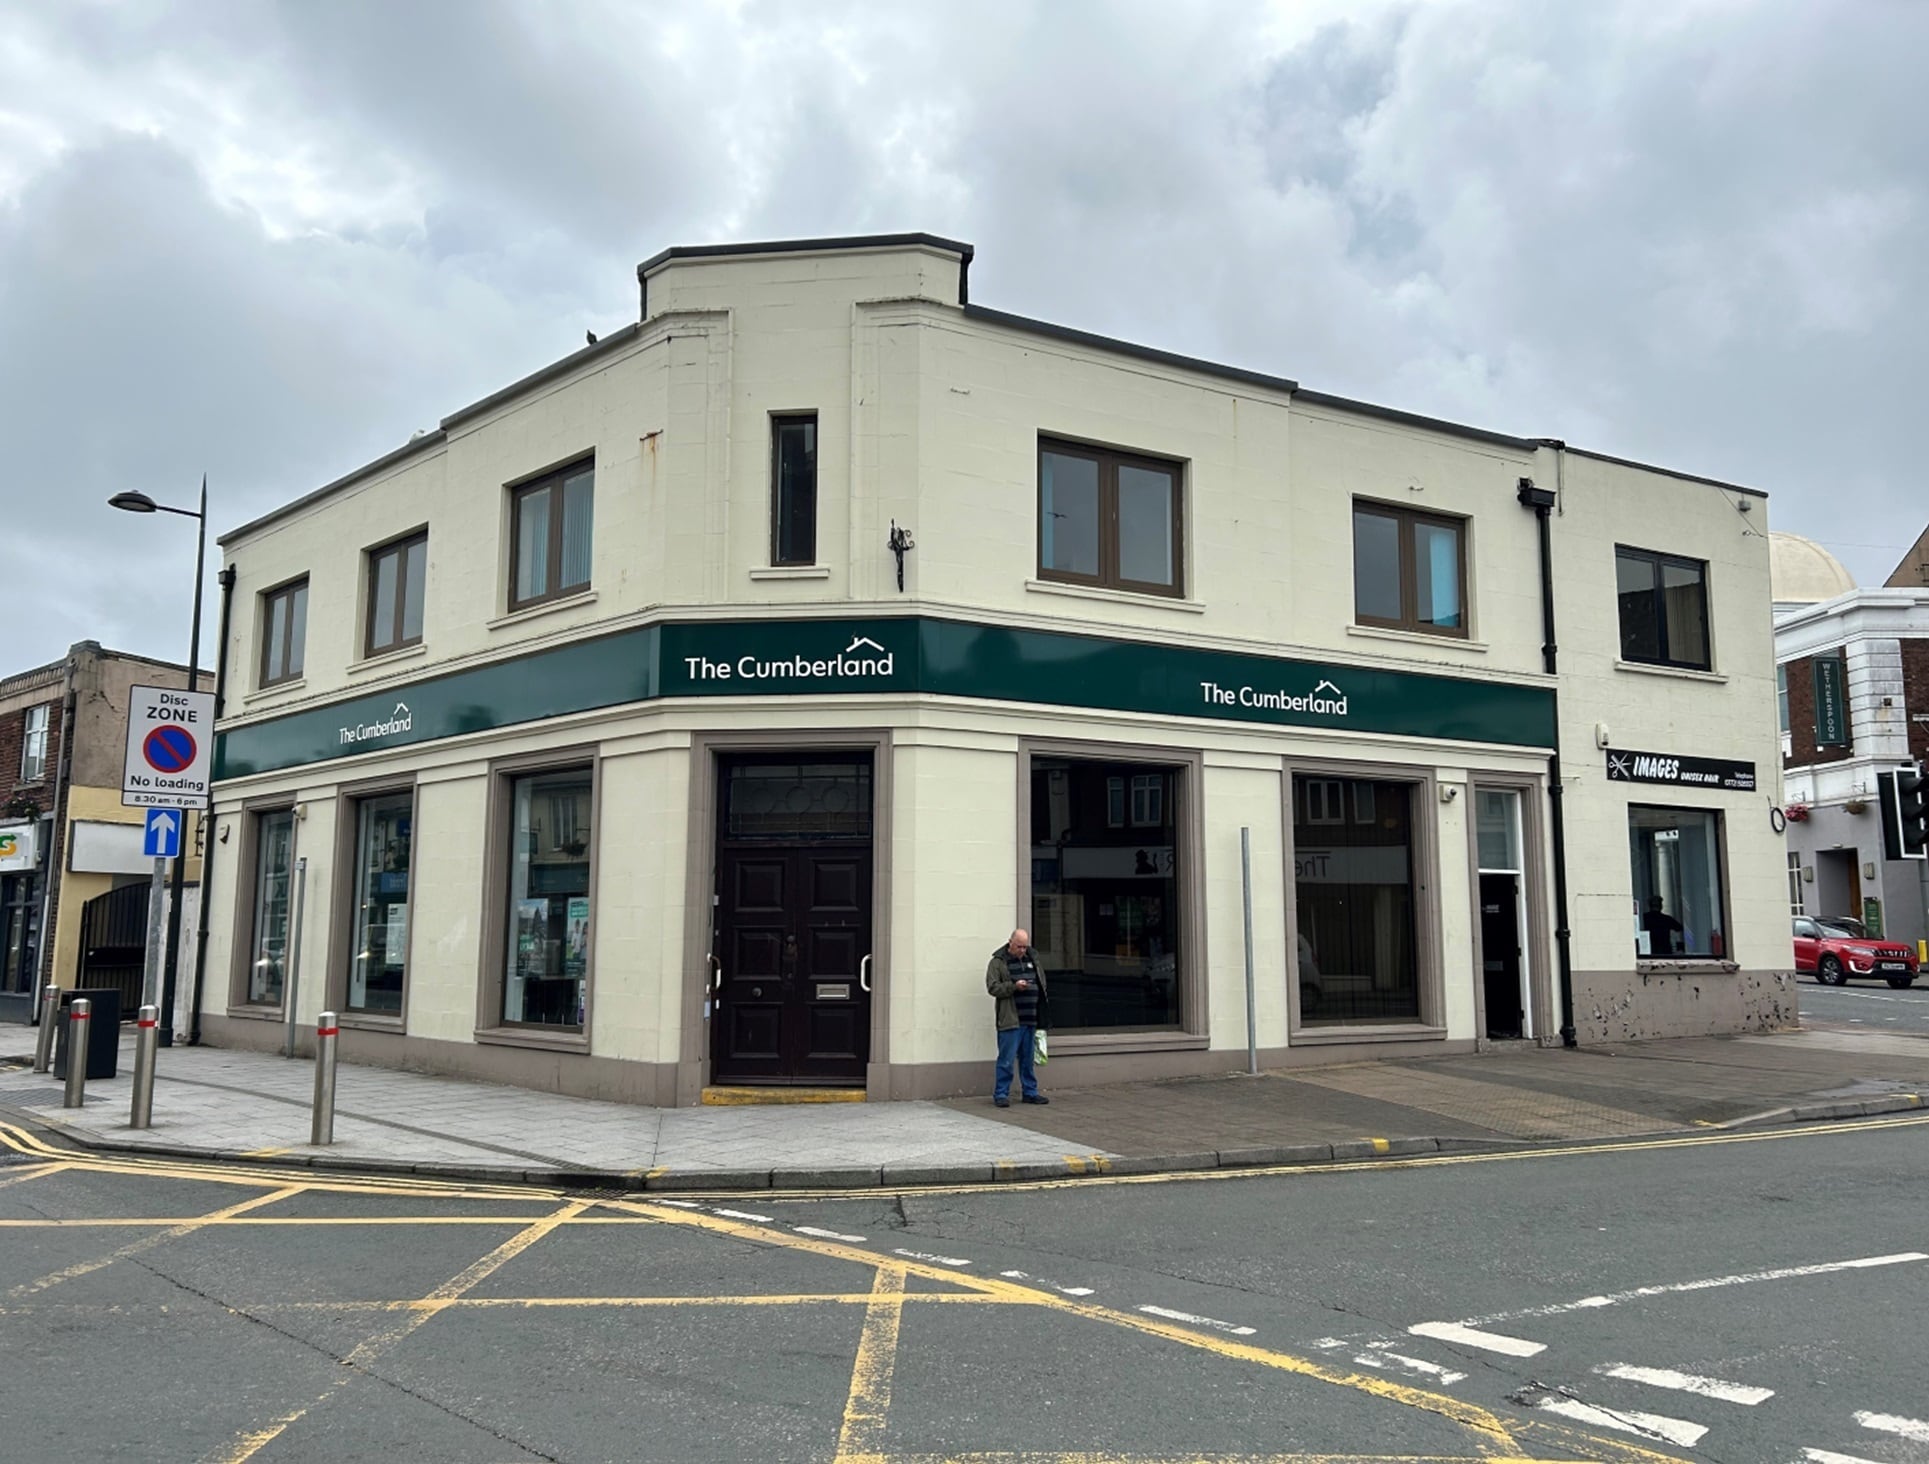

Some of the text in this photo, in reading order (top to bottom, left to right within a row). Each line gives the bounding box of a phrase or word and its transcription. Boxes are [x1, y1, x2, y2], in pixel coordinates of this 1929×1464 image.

[685, 653, 893, 679] The Cumberland
[160, 693, 189, 706] Disc
[1200, 682, 1348, 715] The Cumberland
[1822, 663, 1835, 740] WETHERSPOON
[146, 706, 198, 723] ZONE
[339, 712, 412, 745] The Cumberland
[1633, 756, 1680, 780] IMAGES
[130, 775, 204, 791] No loading
[183, 799, 198, 807] pm
